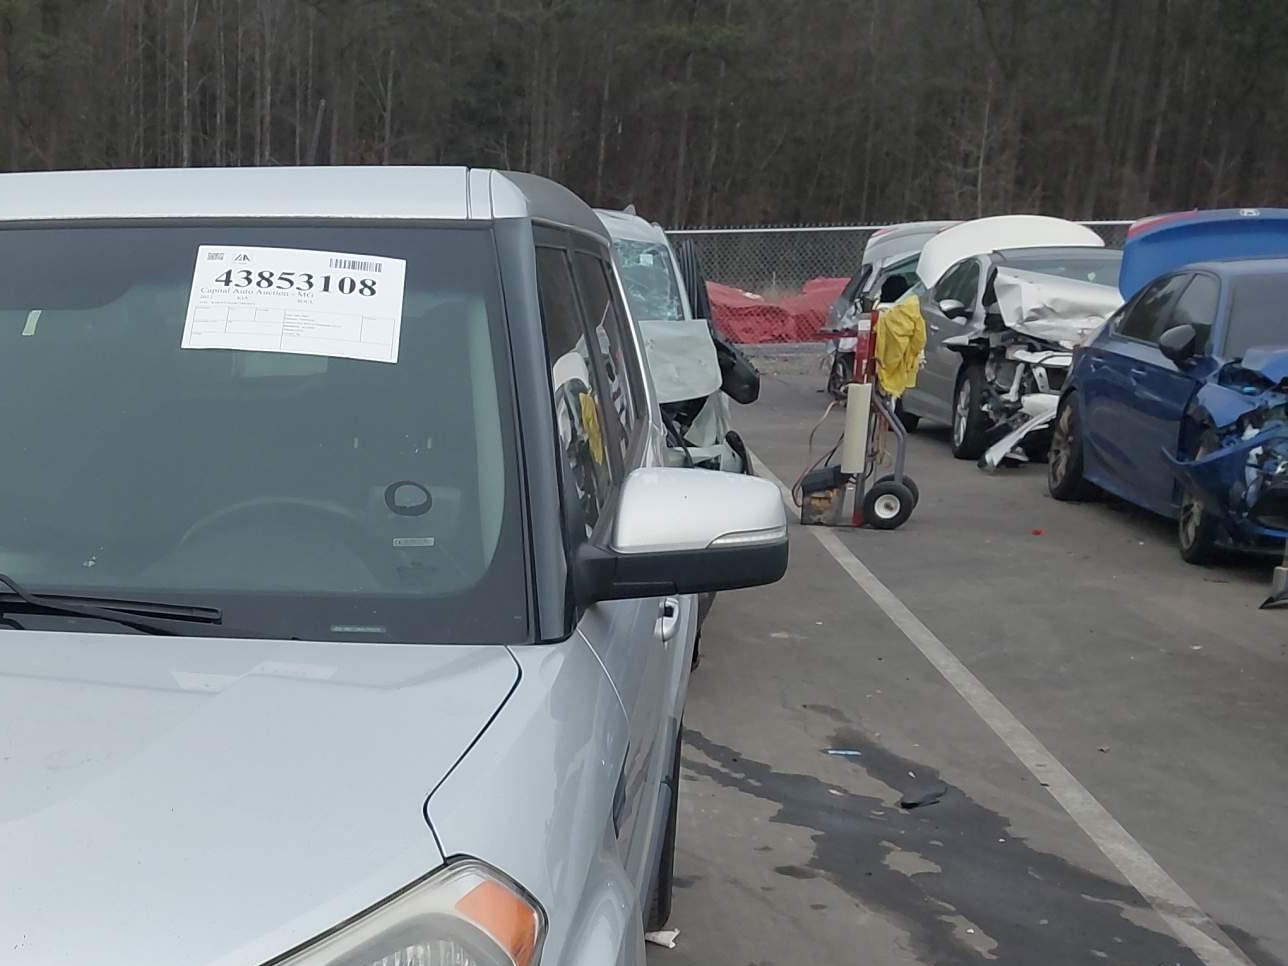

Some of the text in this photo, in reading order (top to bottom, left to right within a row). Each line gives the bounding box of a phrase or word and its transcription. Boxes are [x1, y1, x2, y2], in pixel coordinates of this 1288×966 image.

[200, 287, 230, 296] Capital
[232, 288, 254, 296] Auto
[255, 289, 289, 298] Auction
[214, 268, 377, 297] 43853108
